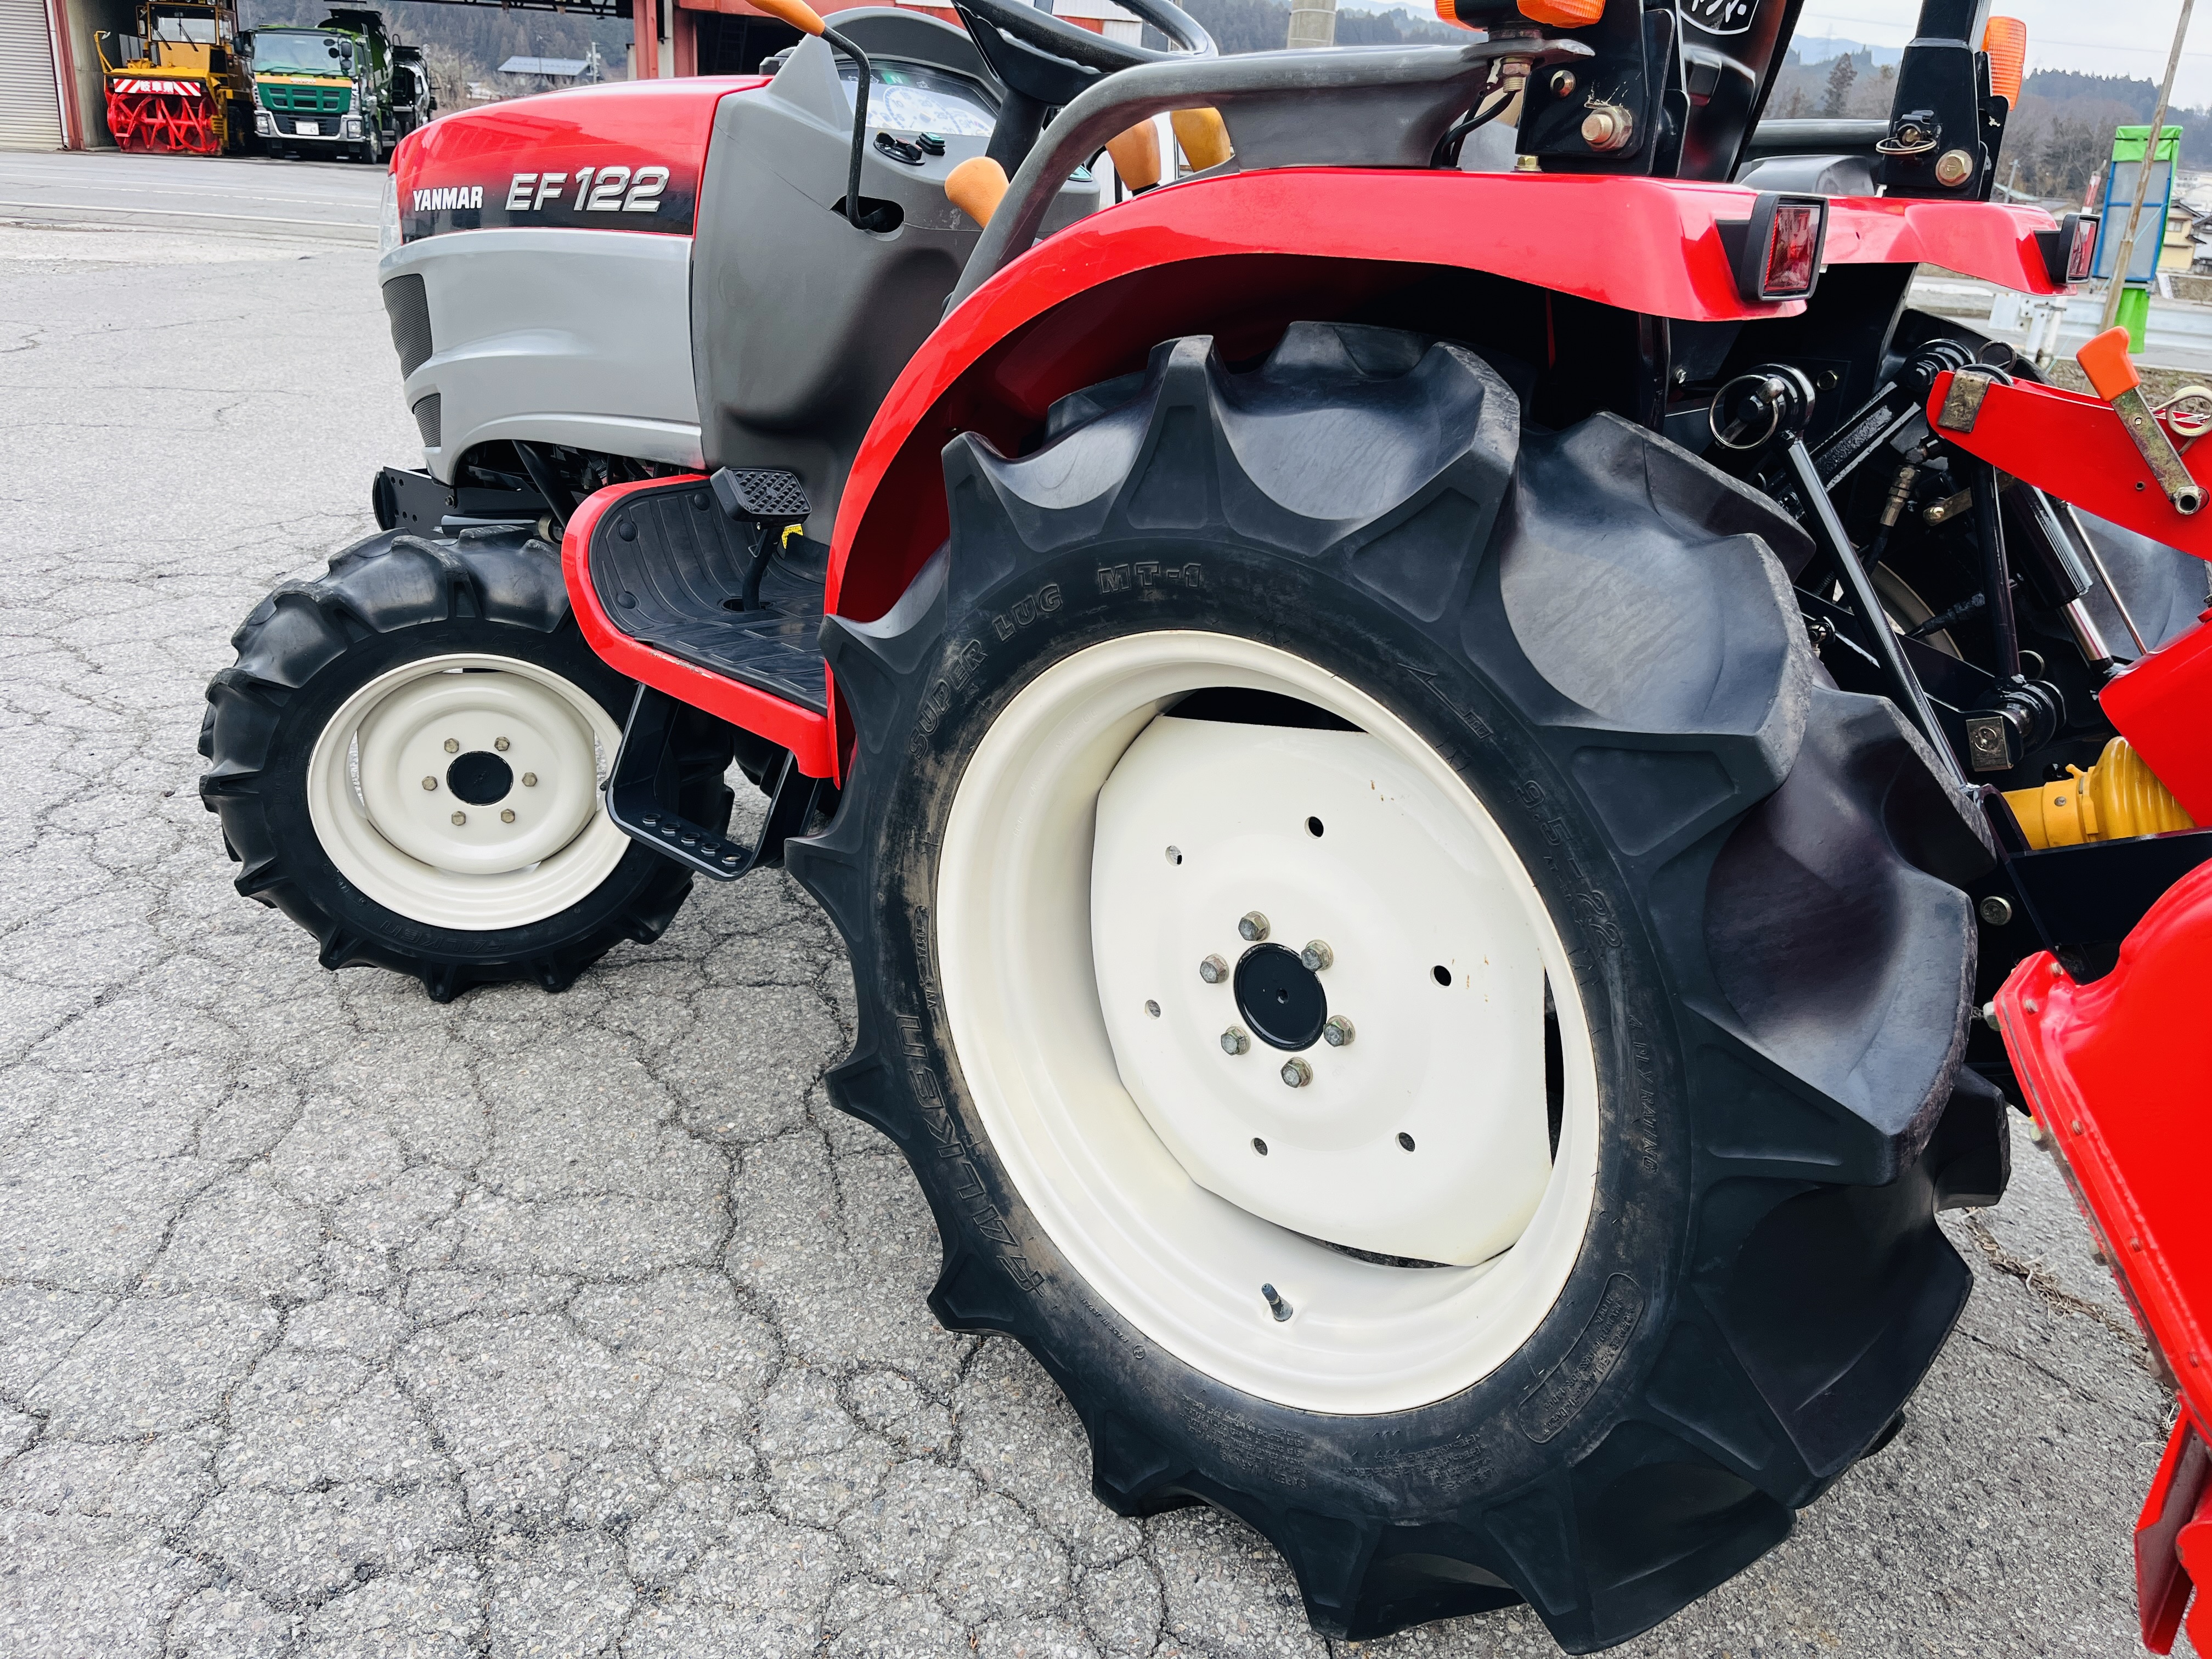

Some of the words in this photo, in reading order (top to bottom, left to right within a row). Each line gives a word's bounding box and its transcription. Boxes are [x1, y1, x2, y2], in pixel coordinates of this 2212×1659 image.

[413, 186, 483, 212] YANMAR
[908, 639, 988, 761] SUPER
[991, 582, 1064, 637] LUG
[1098, 561, 1202, 594] MT-1
[379, 919, 511, 953] FALKEN
[895, 1015, 1045, 1297] FALKEN
[1640, 1088, 1659, 1175] RATING
